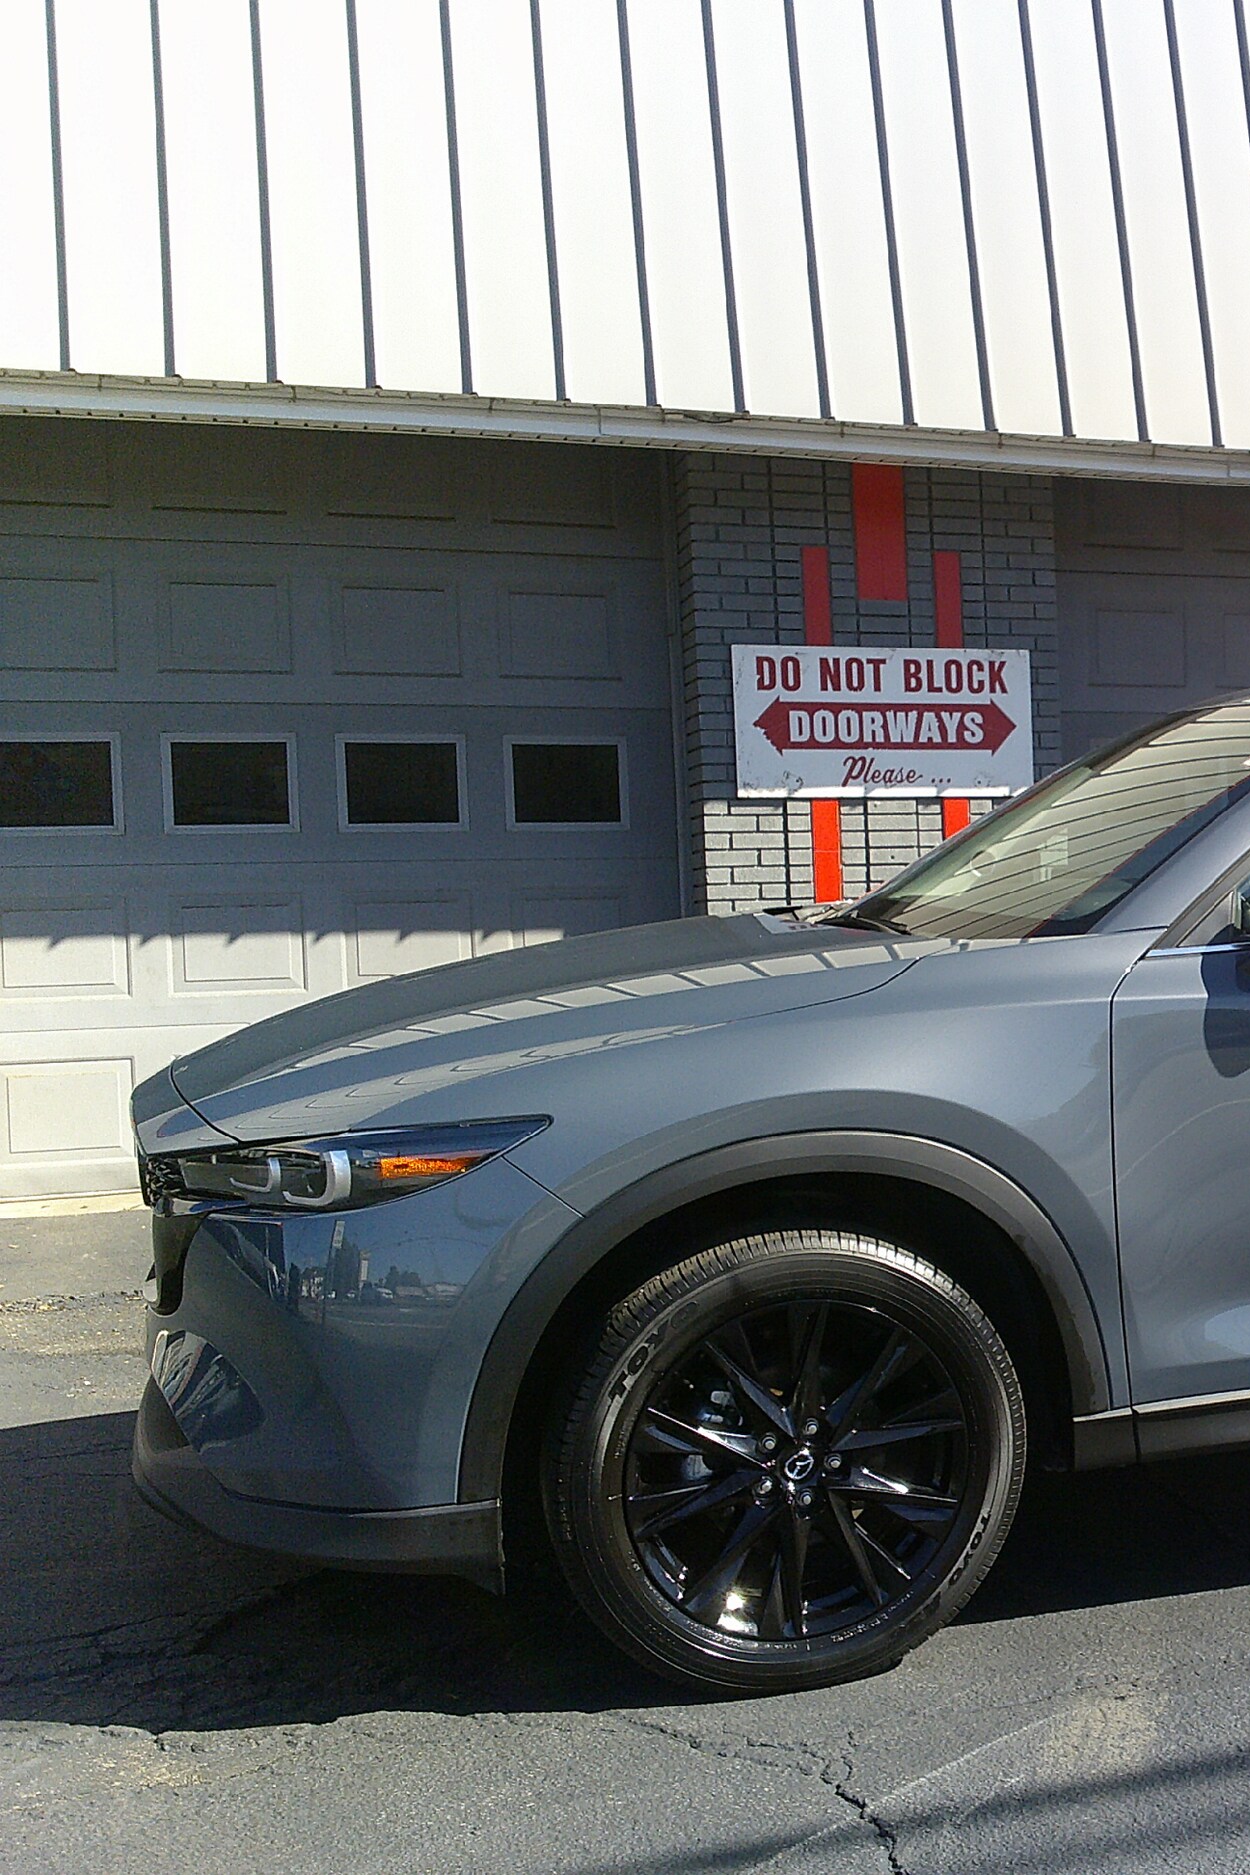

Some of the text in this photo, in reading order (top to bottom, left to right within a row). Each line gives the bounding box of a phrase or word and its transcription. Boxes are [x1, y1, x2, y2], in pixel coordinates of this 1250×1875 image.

[755, 655, 1009, 695] DO NOT BLOCK
[788, 708, 985, 745] DOORWAYS
[841, 755, 924, 788] Please
